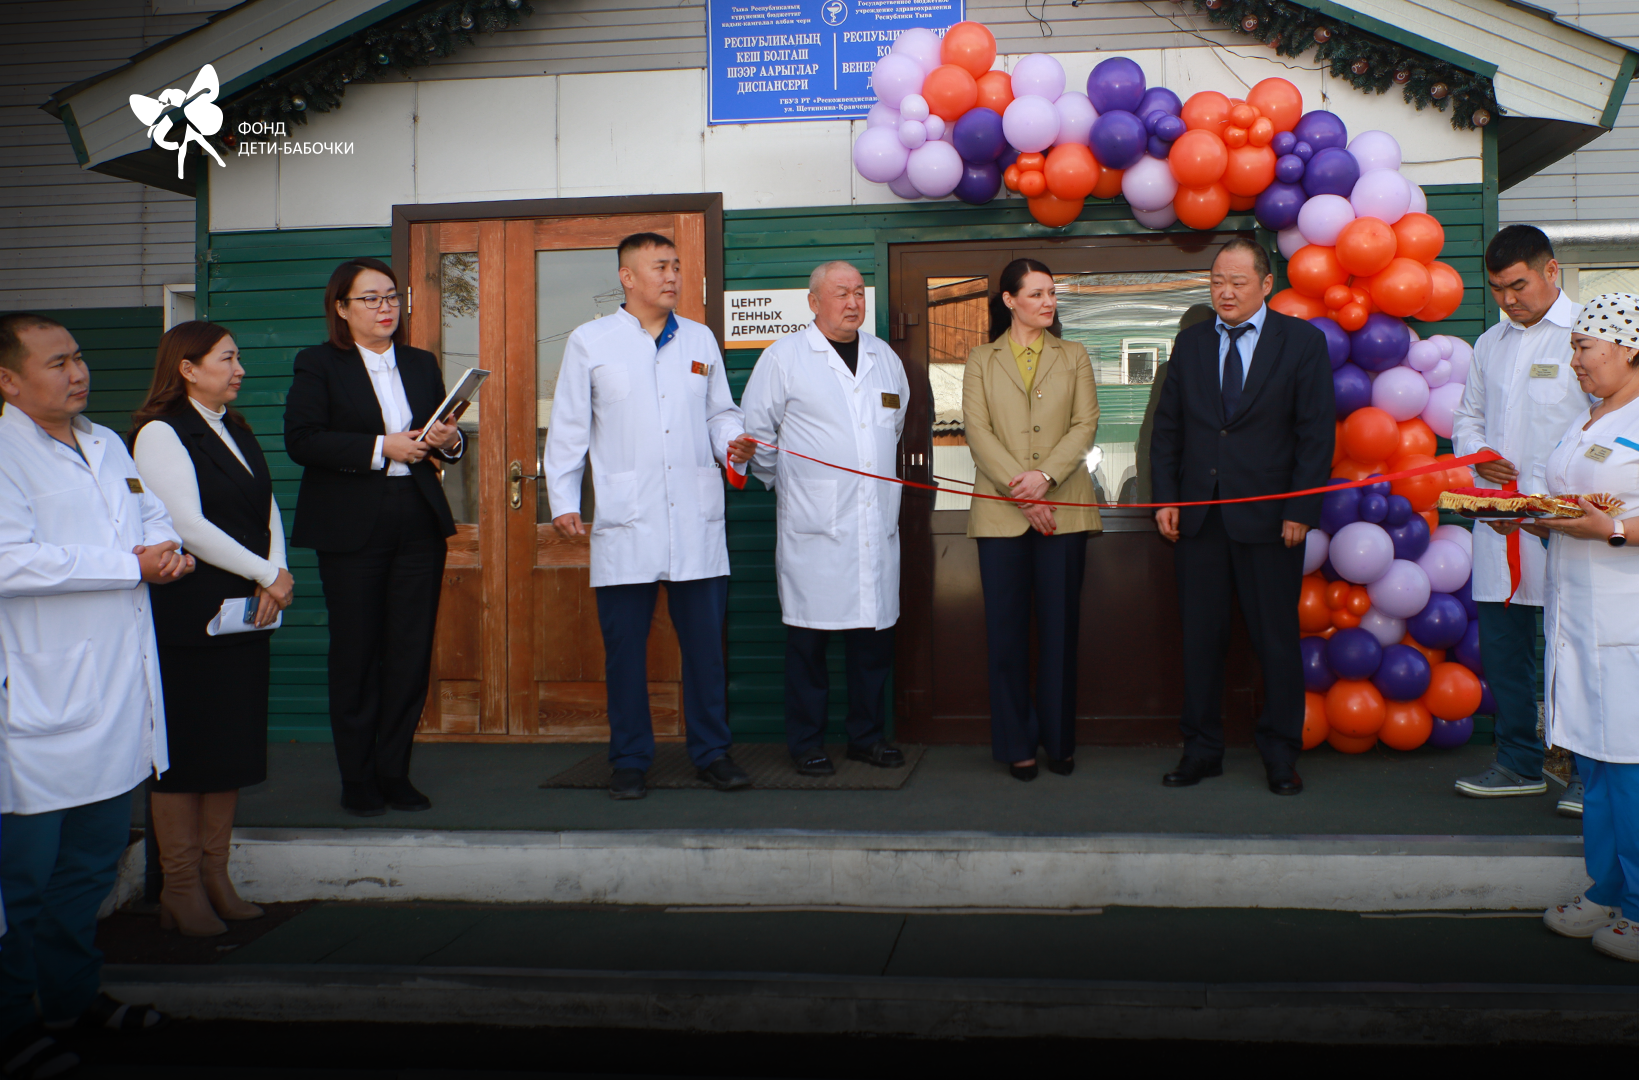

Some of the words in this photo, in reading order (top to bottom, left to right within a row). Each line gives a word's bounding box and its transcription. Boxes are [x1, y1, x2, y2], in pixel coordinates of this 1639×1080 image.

[736, 51, 761, 63] КЕШ
[764, 49, 809, 62] БОЛГАШ
[727, 66, 757, 78] ШЭЭР
[759, 63, 819, 77] ААРЫГЛАР
[737, 79, 809, 95] ДИСПАНСЕРИ
[731, 297, 772, 309] ЦЕНТР
[731, 310, 782, 321] ГЕННЫХ
[731, 323, 810, 336] ДЕРМАТОЗО
